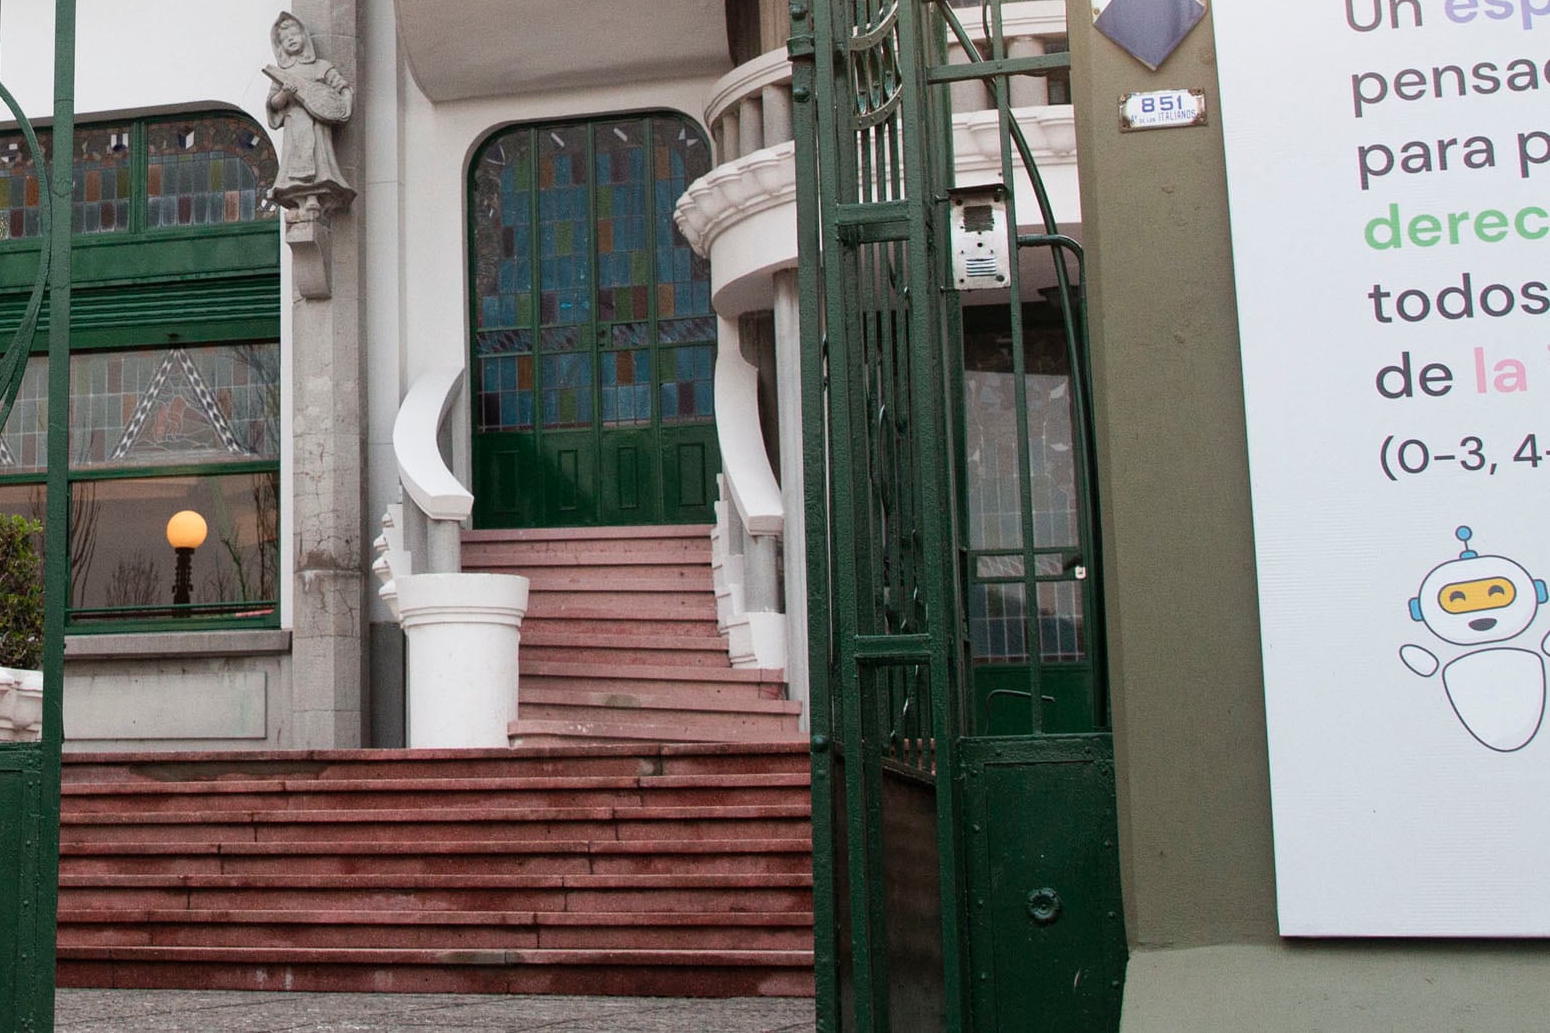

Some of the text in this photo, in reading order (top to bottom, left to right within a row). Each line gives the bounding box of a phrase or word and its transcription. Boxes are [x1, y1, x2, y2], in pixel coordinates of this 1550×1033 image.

[1141, 95, 1182, 113] 851
[1352, 58, 1550, 118] pensa
[1158, 109, 1196, 122] ITALIANOS
[1358, 136, 1496, 190] para
[1367, 272, 1550, 323] todos
[1375, 347, 1528, 399] de la
